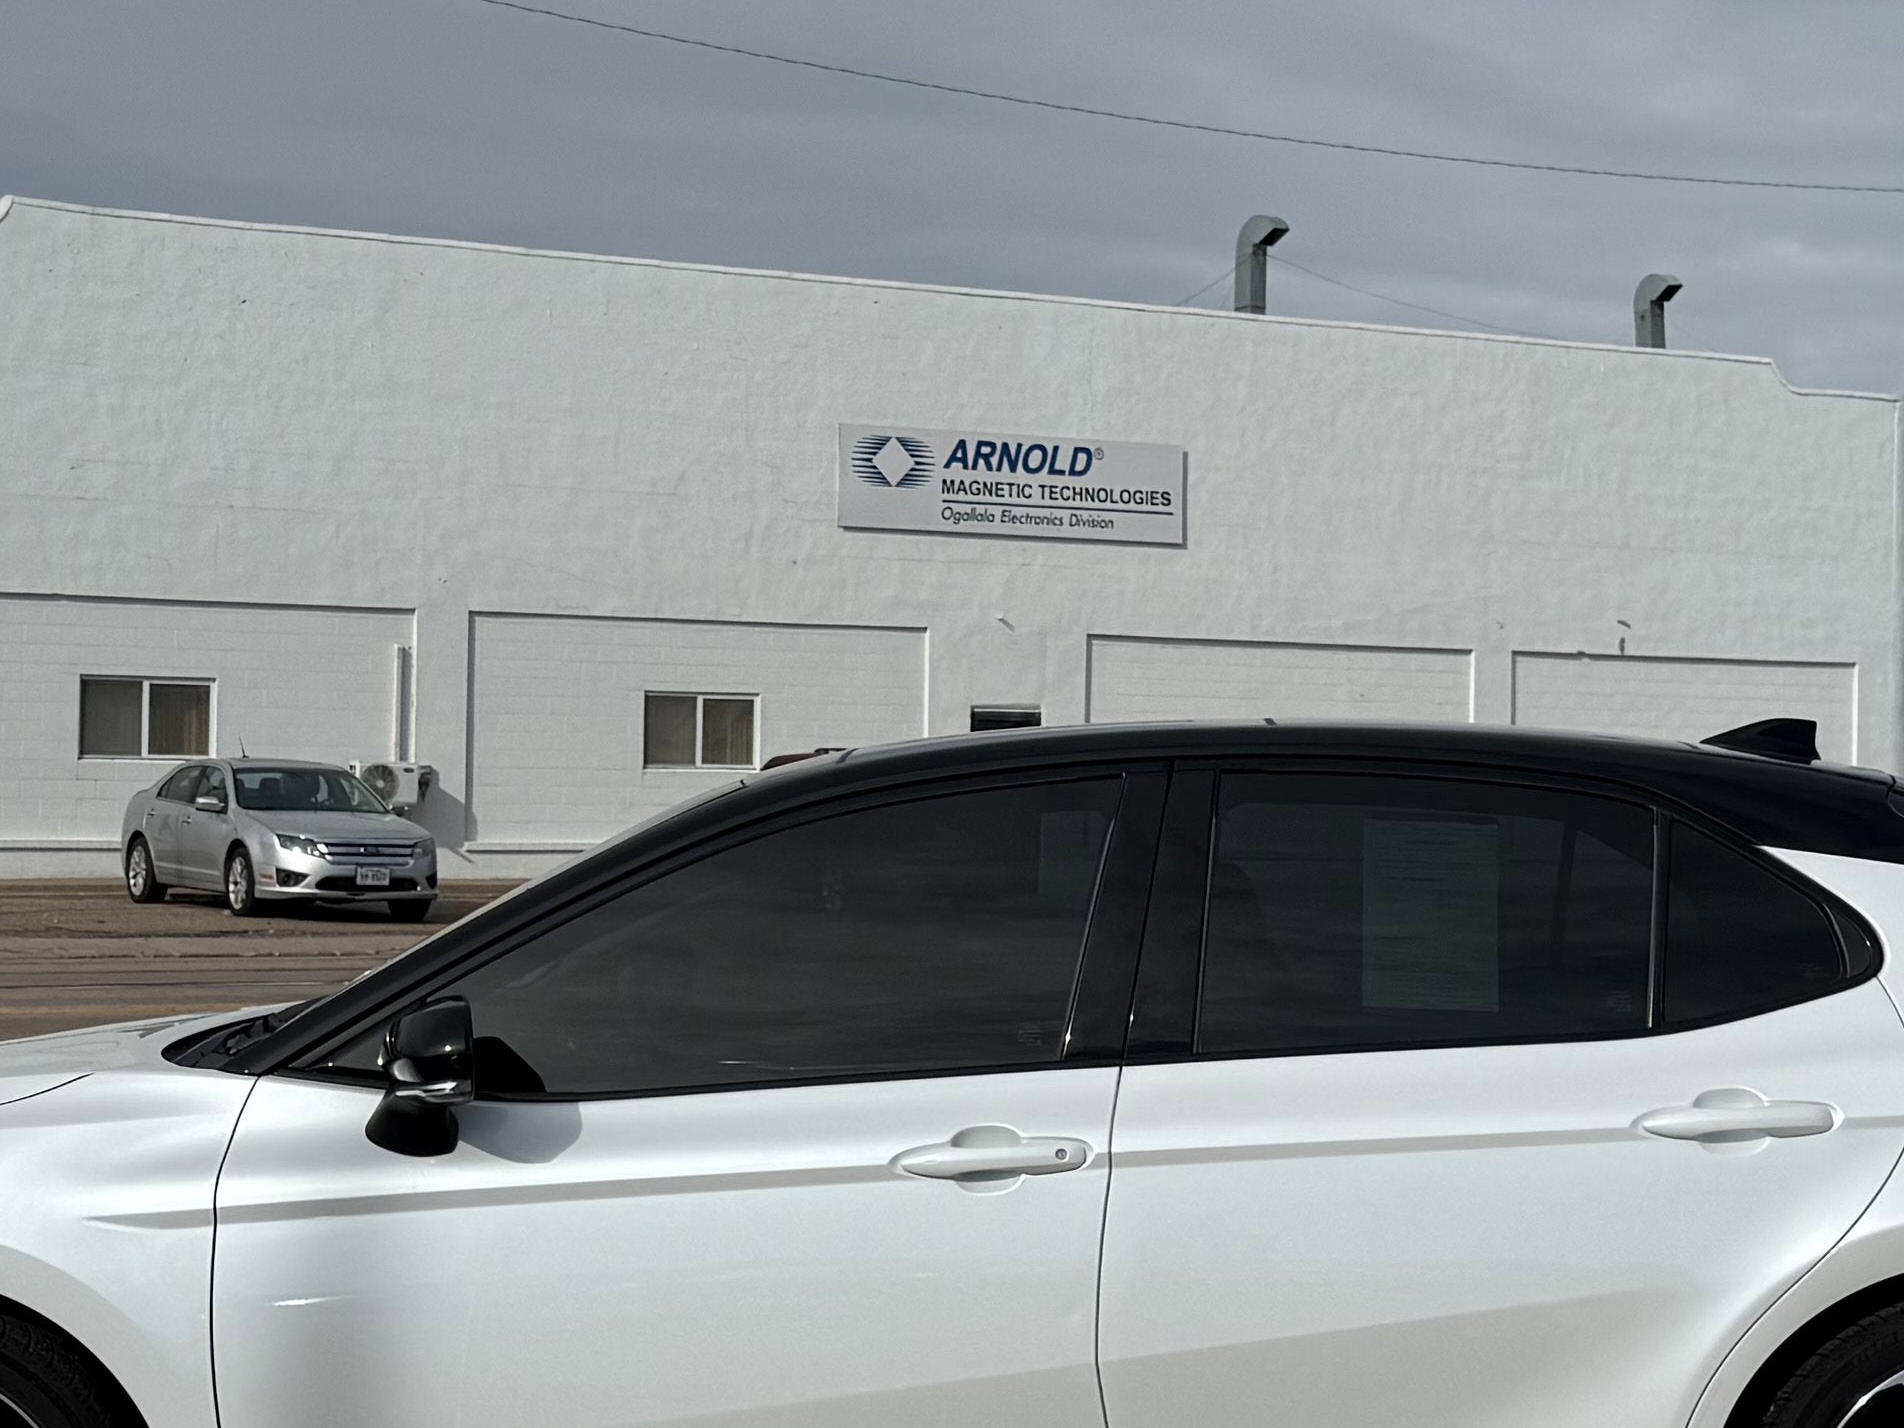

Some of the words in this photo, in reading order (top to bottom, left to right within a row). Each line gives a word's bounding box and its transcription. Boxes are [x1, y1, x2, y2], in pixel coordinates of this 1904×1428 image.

[943, 438, 1094, 478] ARNOLD
[941, 478, 1034, 500] MAGNETIC
[1038, 483, 1173, 507] TECHNOLOGIES
[941, 506, 996, 525] Ogallala
[999, 509, 1065, 528] Electronics
[1068, 512, 1115, 530] Division
